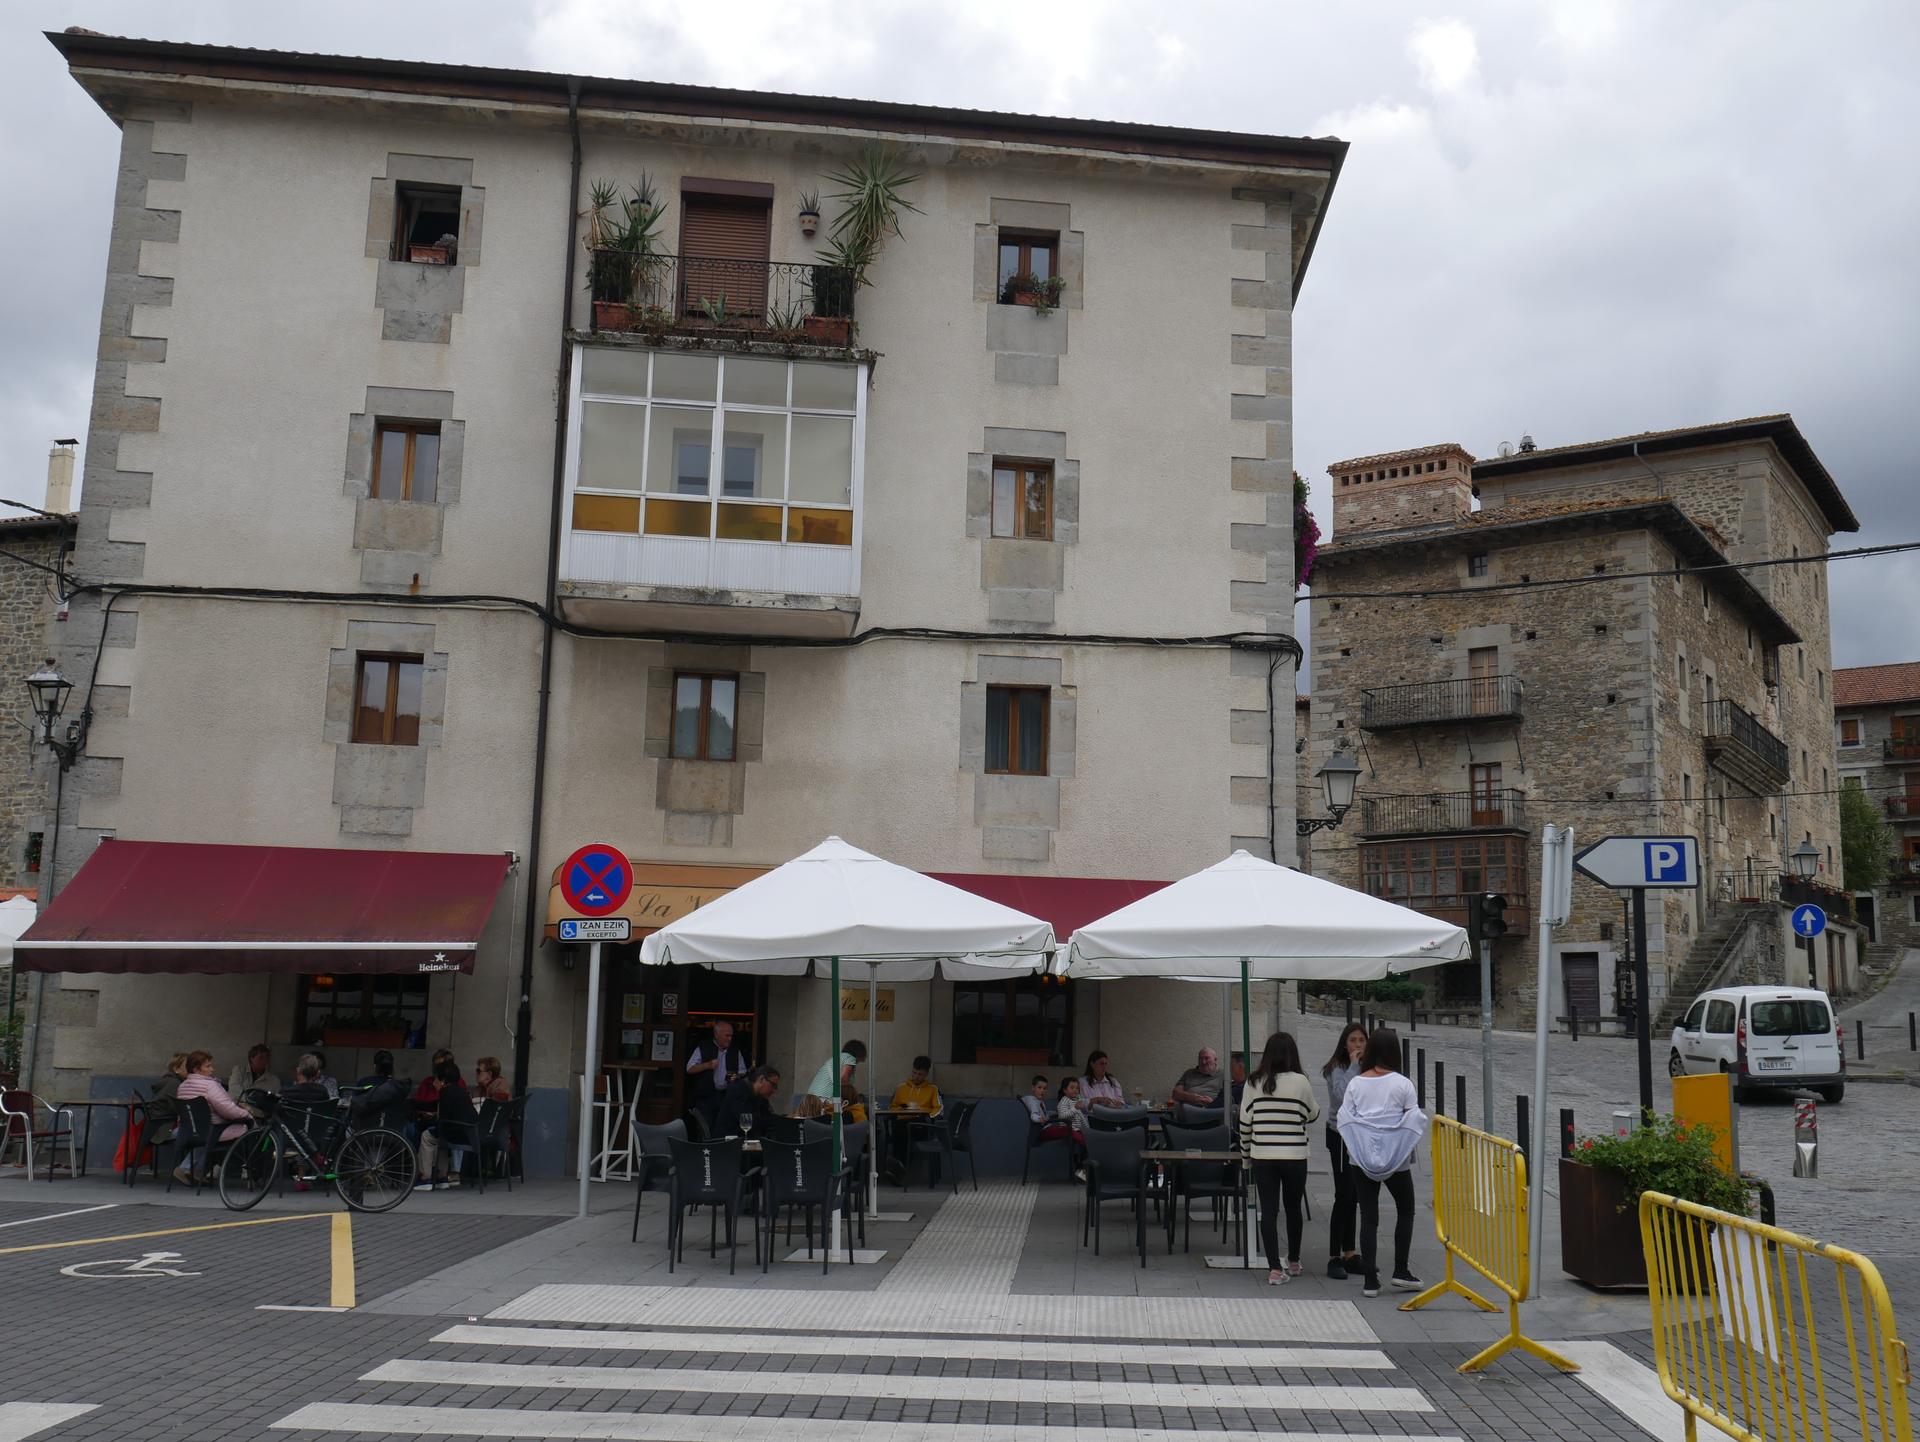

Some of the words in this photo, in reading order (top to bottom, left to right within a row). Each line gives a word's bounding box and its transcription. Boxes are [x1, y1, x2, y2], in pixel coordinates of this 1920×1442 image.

[1650, 844, 1679, 879] P
[634, 893, 672, 917] La
[580, 921, 601, 929] IZAN
[603, 921, 624, 929] EZIK
[418, 963, 460, 972] Heineken
[863, 999, 889, 1012] Vlla
